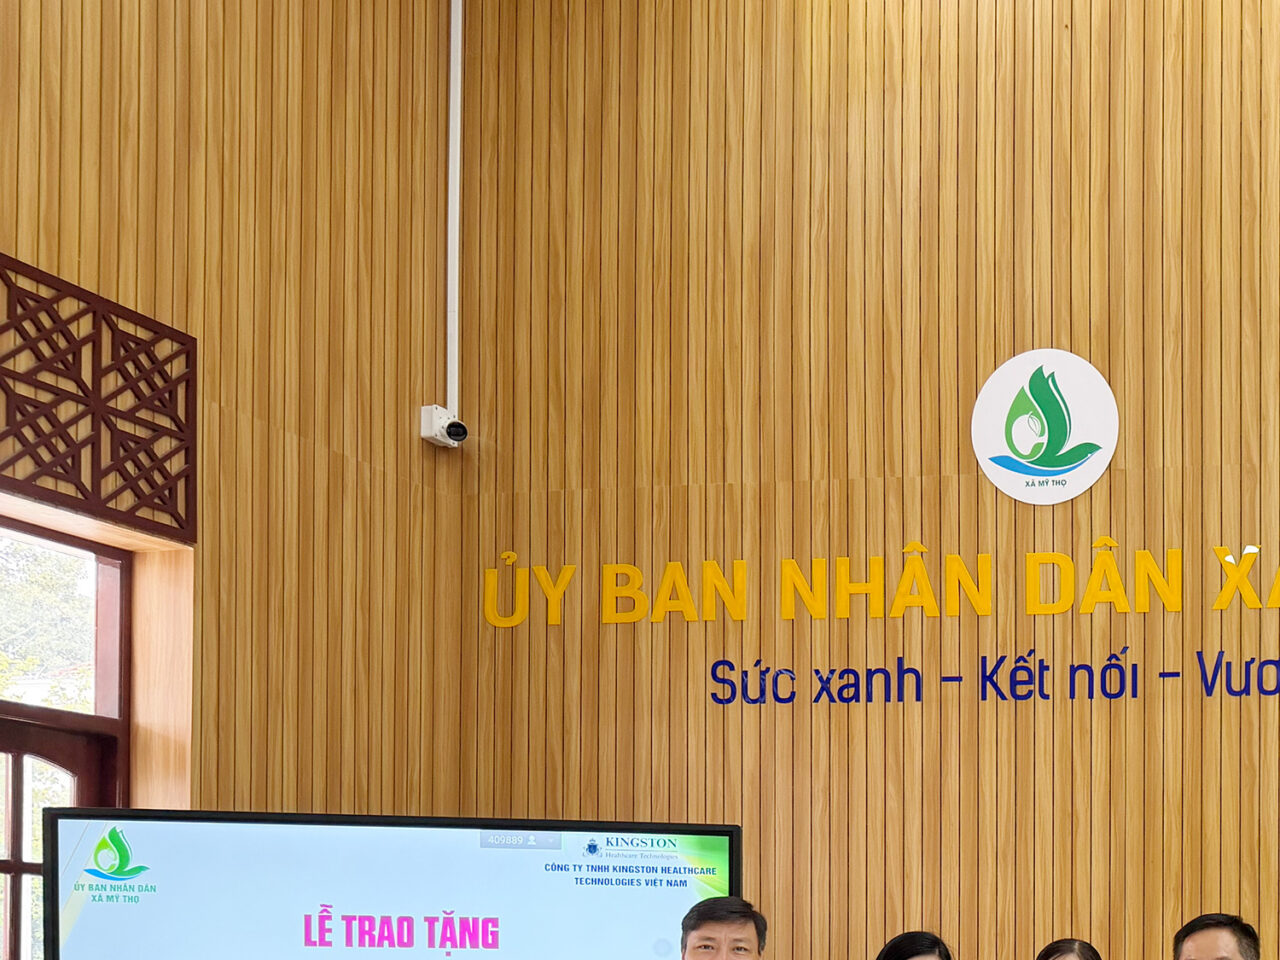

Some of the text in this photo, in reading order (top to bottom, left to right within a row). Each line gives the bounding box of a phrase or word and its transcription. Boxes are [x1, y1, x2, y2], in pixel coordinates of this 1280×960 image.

[484, 551, 576, 628] ỦY
[602, 559, 747, 624] BAN
[781, 541, 992, 620] NHÂN
[1026, 535, 1182, 616] DÂN
[710, 659, 796, 705] Sức
[812, 656, 923, 703] xanh
[980, 649, 1050, 701] Kết
[1069, 646, 1138, 700] nối
[488, 835, 523, 845] 409889
[606, 837, 678, 848] KINGSTON
[640, 852, 678, 861] Technologies
[544, 863, 717, 876] CÔNG TY TNHH KINGSTON HEALTHCARE
[74, 881, 156, 892] ỦY BAN NHÂN DÂN
[574, 877, 688, 889] TECHNOLOGIES VIỆT NAM
[91, 894, 140, 904] XÃ MỸ THỌ
[304, 904, 500, 957] LỄ TRAO TẶNG
